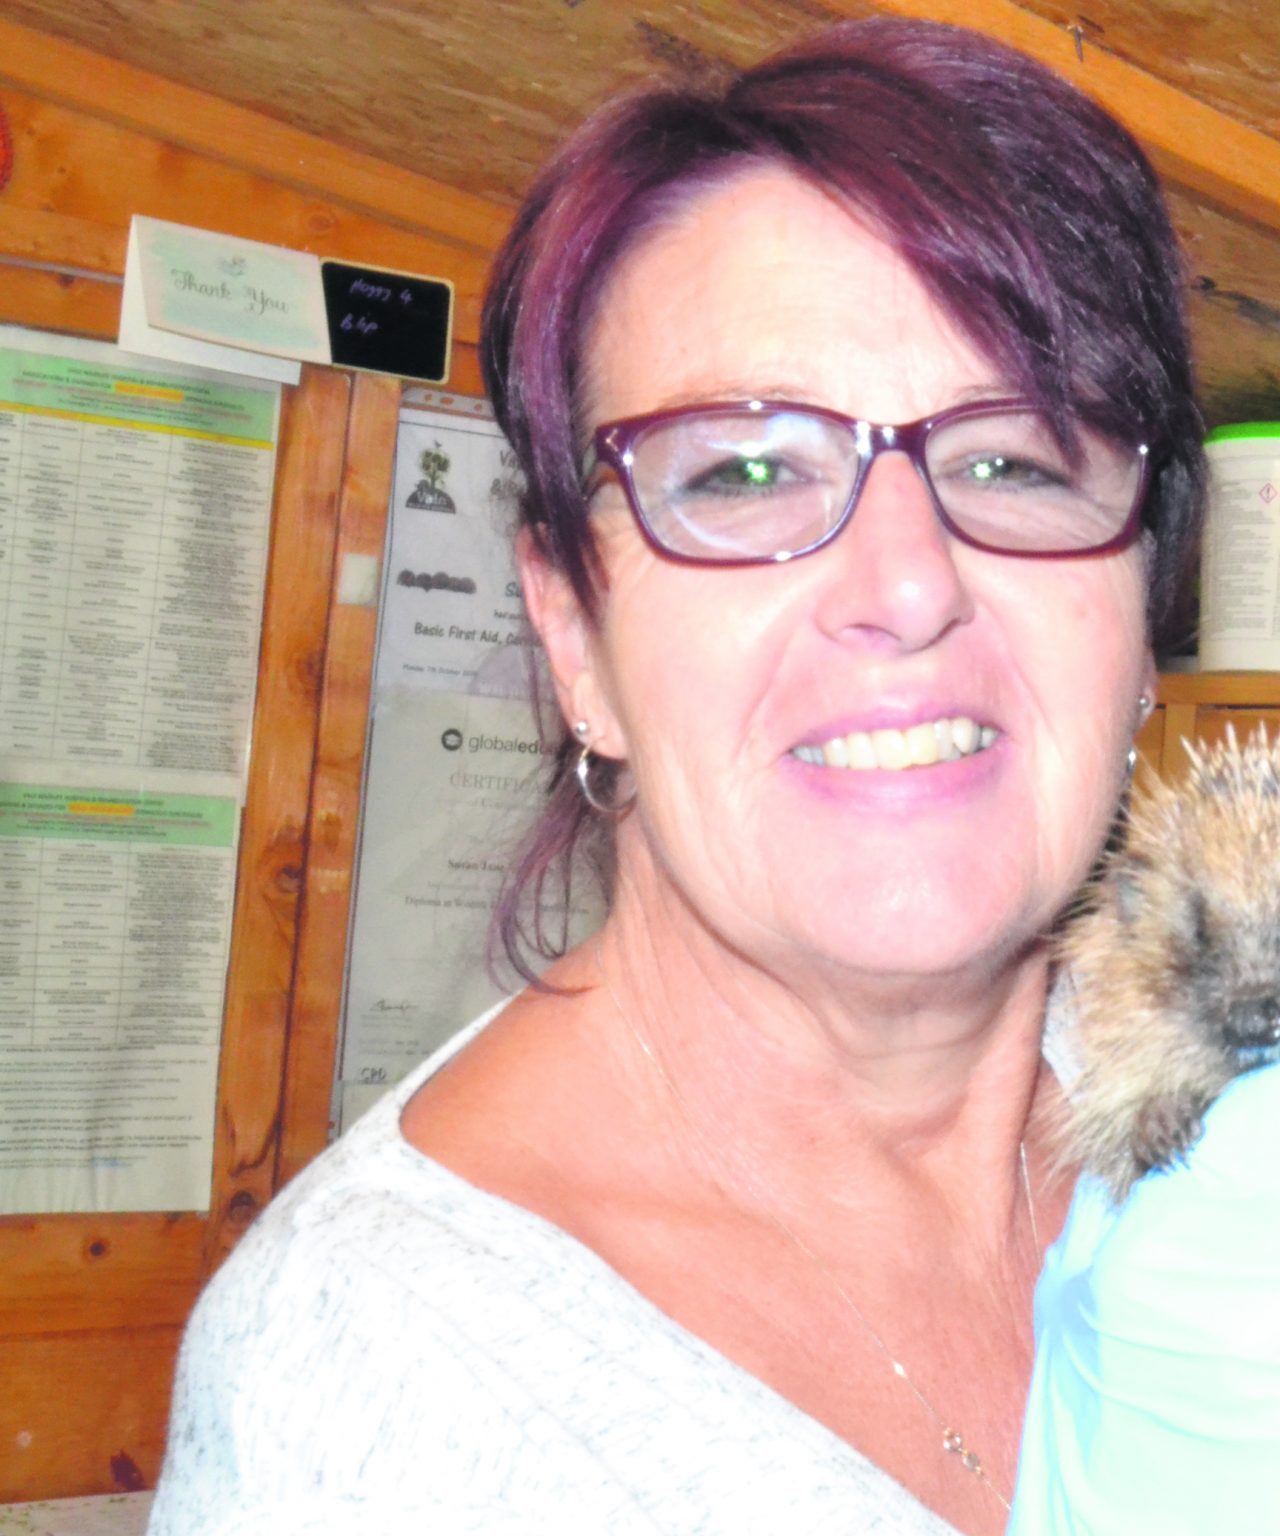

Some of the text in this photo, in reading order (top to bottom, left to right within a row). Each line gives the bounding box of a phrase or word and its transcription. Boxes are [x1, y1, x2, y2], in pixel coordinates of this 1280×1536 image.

[170, 268, 289, 315] Thank You
[414, 622, 444, 637] Basic
[449, 625, 476, 640] First
[480, 630, 502, 645] Aid,
